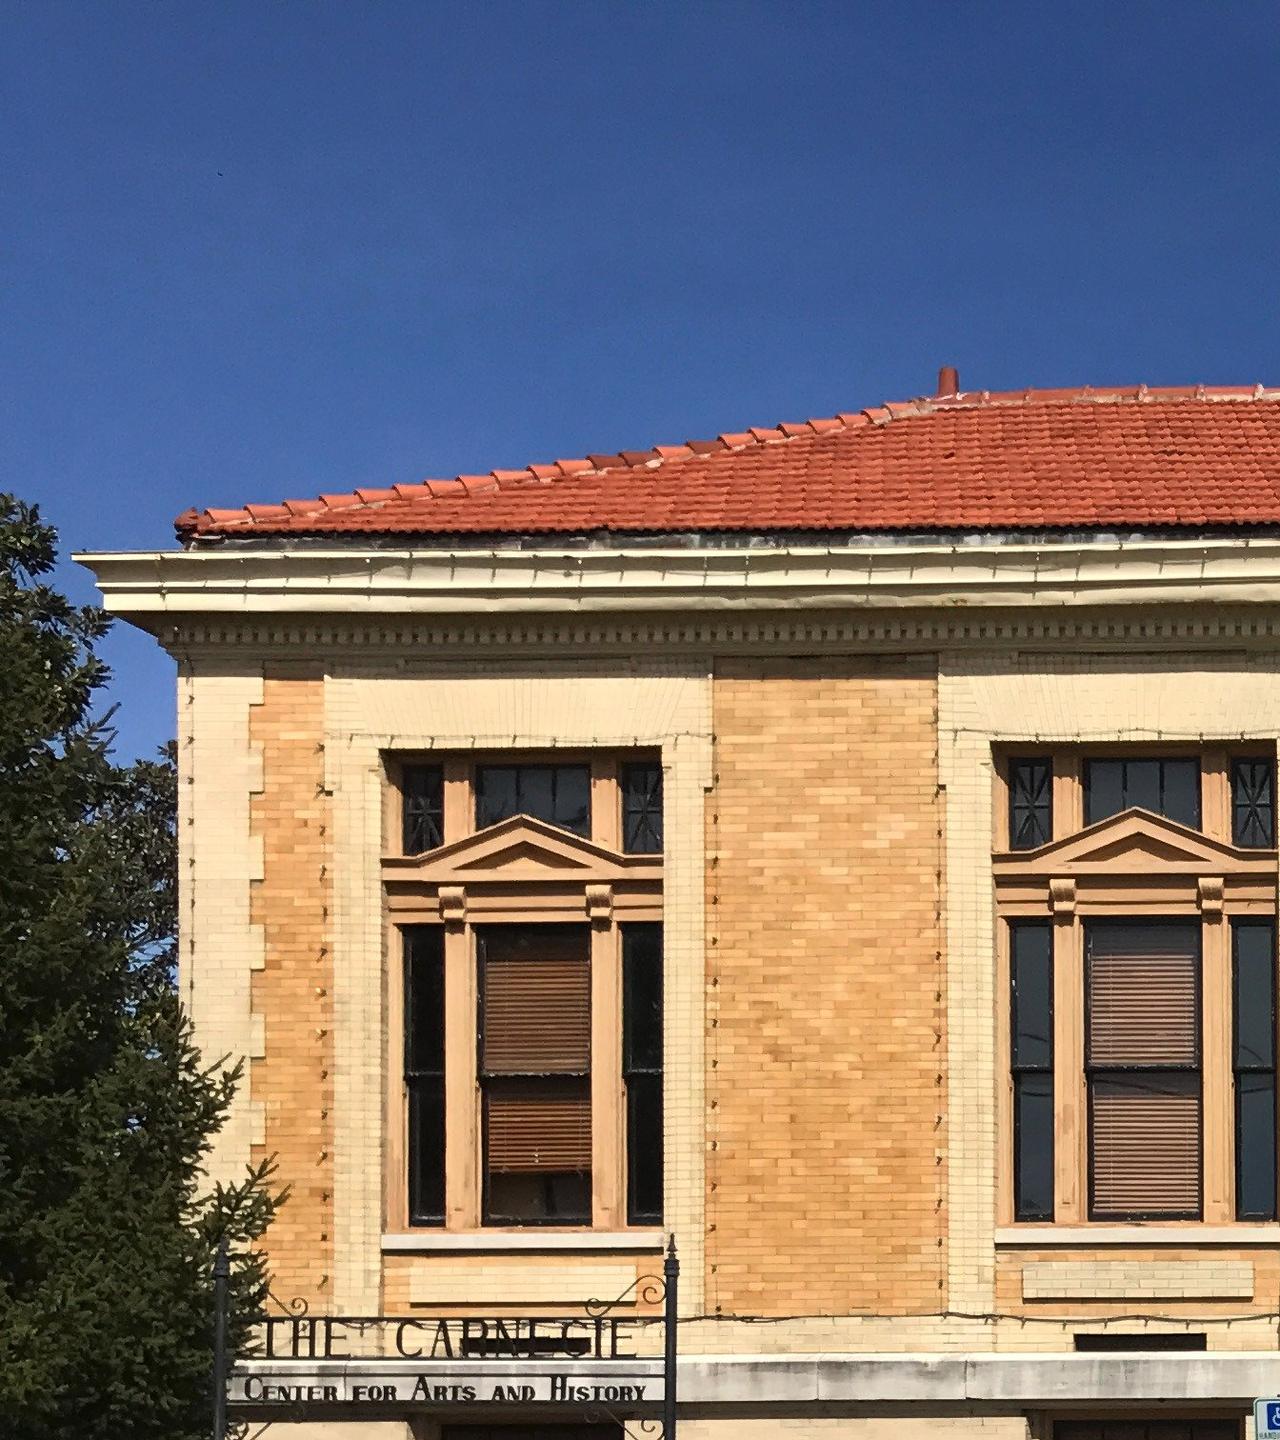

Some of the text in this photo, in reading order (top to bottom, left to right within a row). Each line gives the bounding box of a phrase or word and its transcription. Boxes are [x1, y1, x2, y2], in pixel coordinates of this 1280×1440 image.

[262, 1318, 351, 1358] THE
[244, 1376, 647, 1402] CENTER FOR ARTS AND HISTORY
